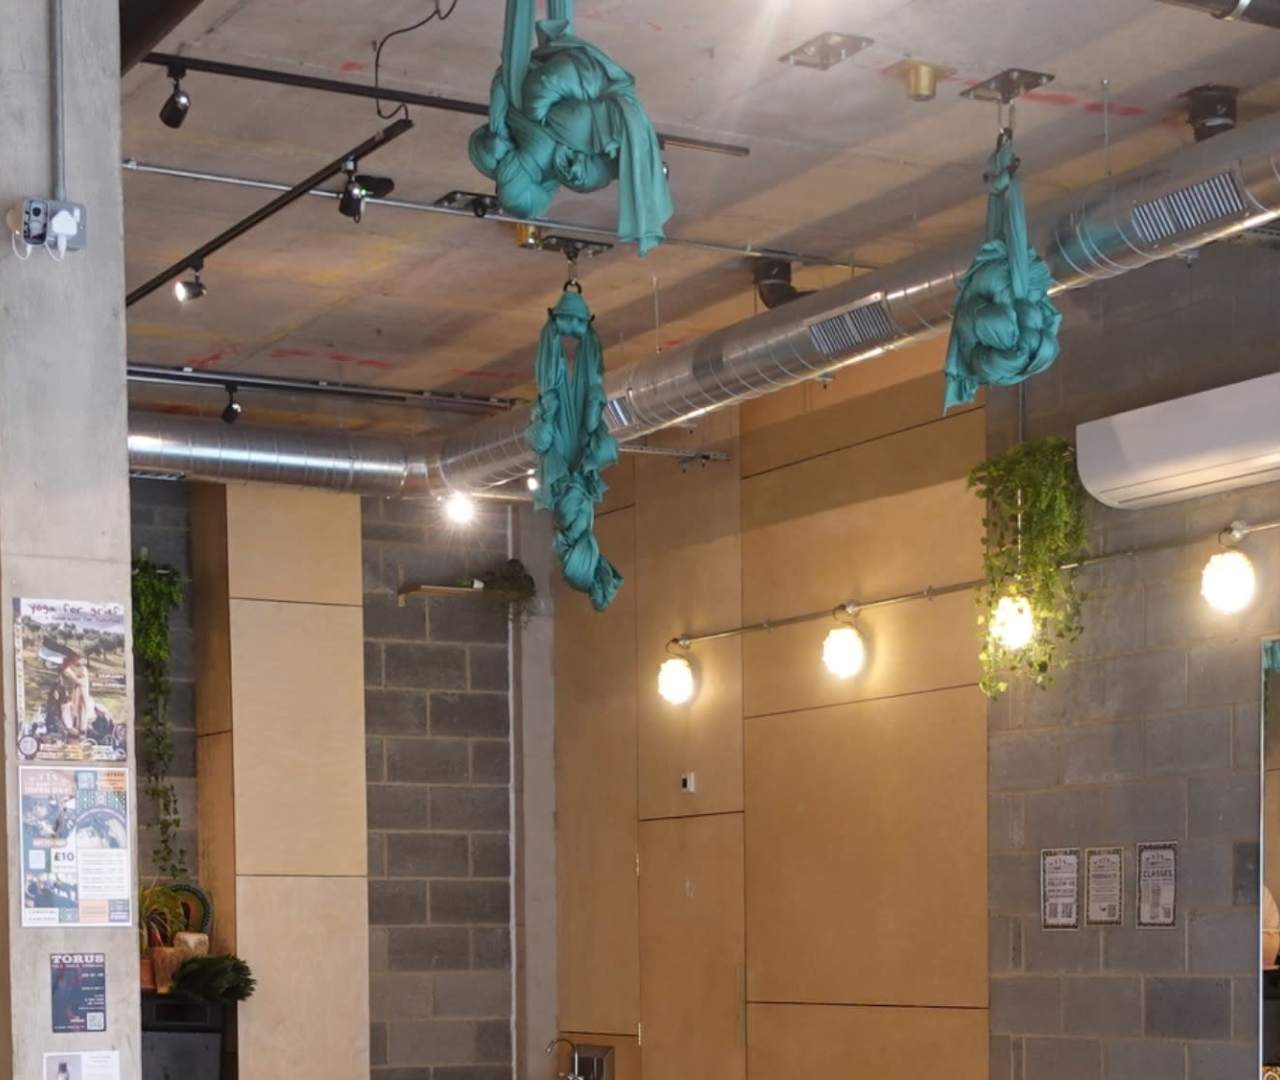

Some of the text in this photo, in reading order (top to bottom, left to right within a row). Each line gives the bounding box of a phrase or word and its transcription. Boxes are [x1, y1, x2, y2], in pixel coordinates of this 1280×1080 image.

[28, 604, 56, 614] yoga
[63, 603, 83, 615] for
[54, 852, 75, 861] £10
[51, 954, 105, 964] TORUS
